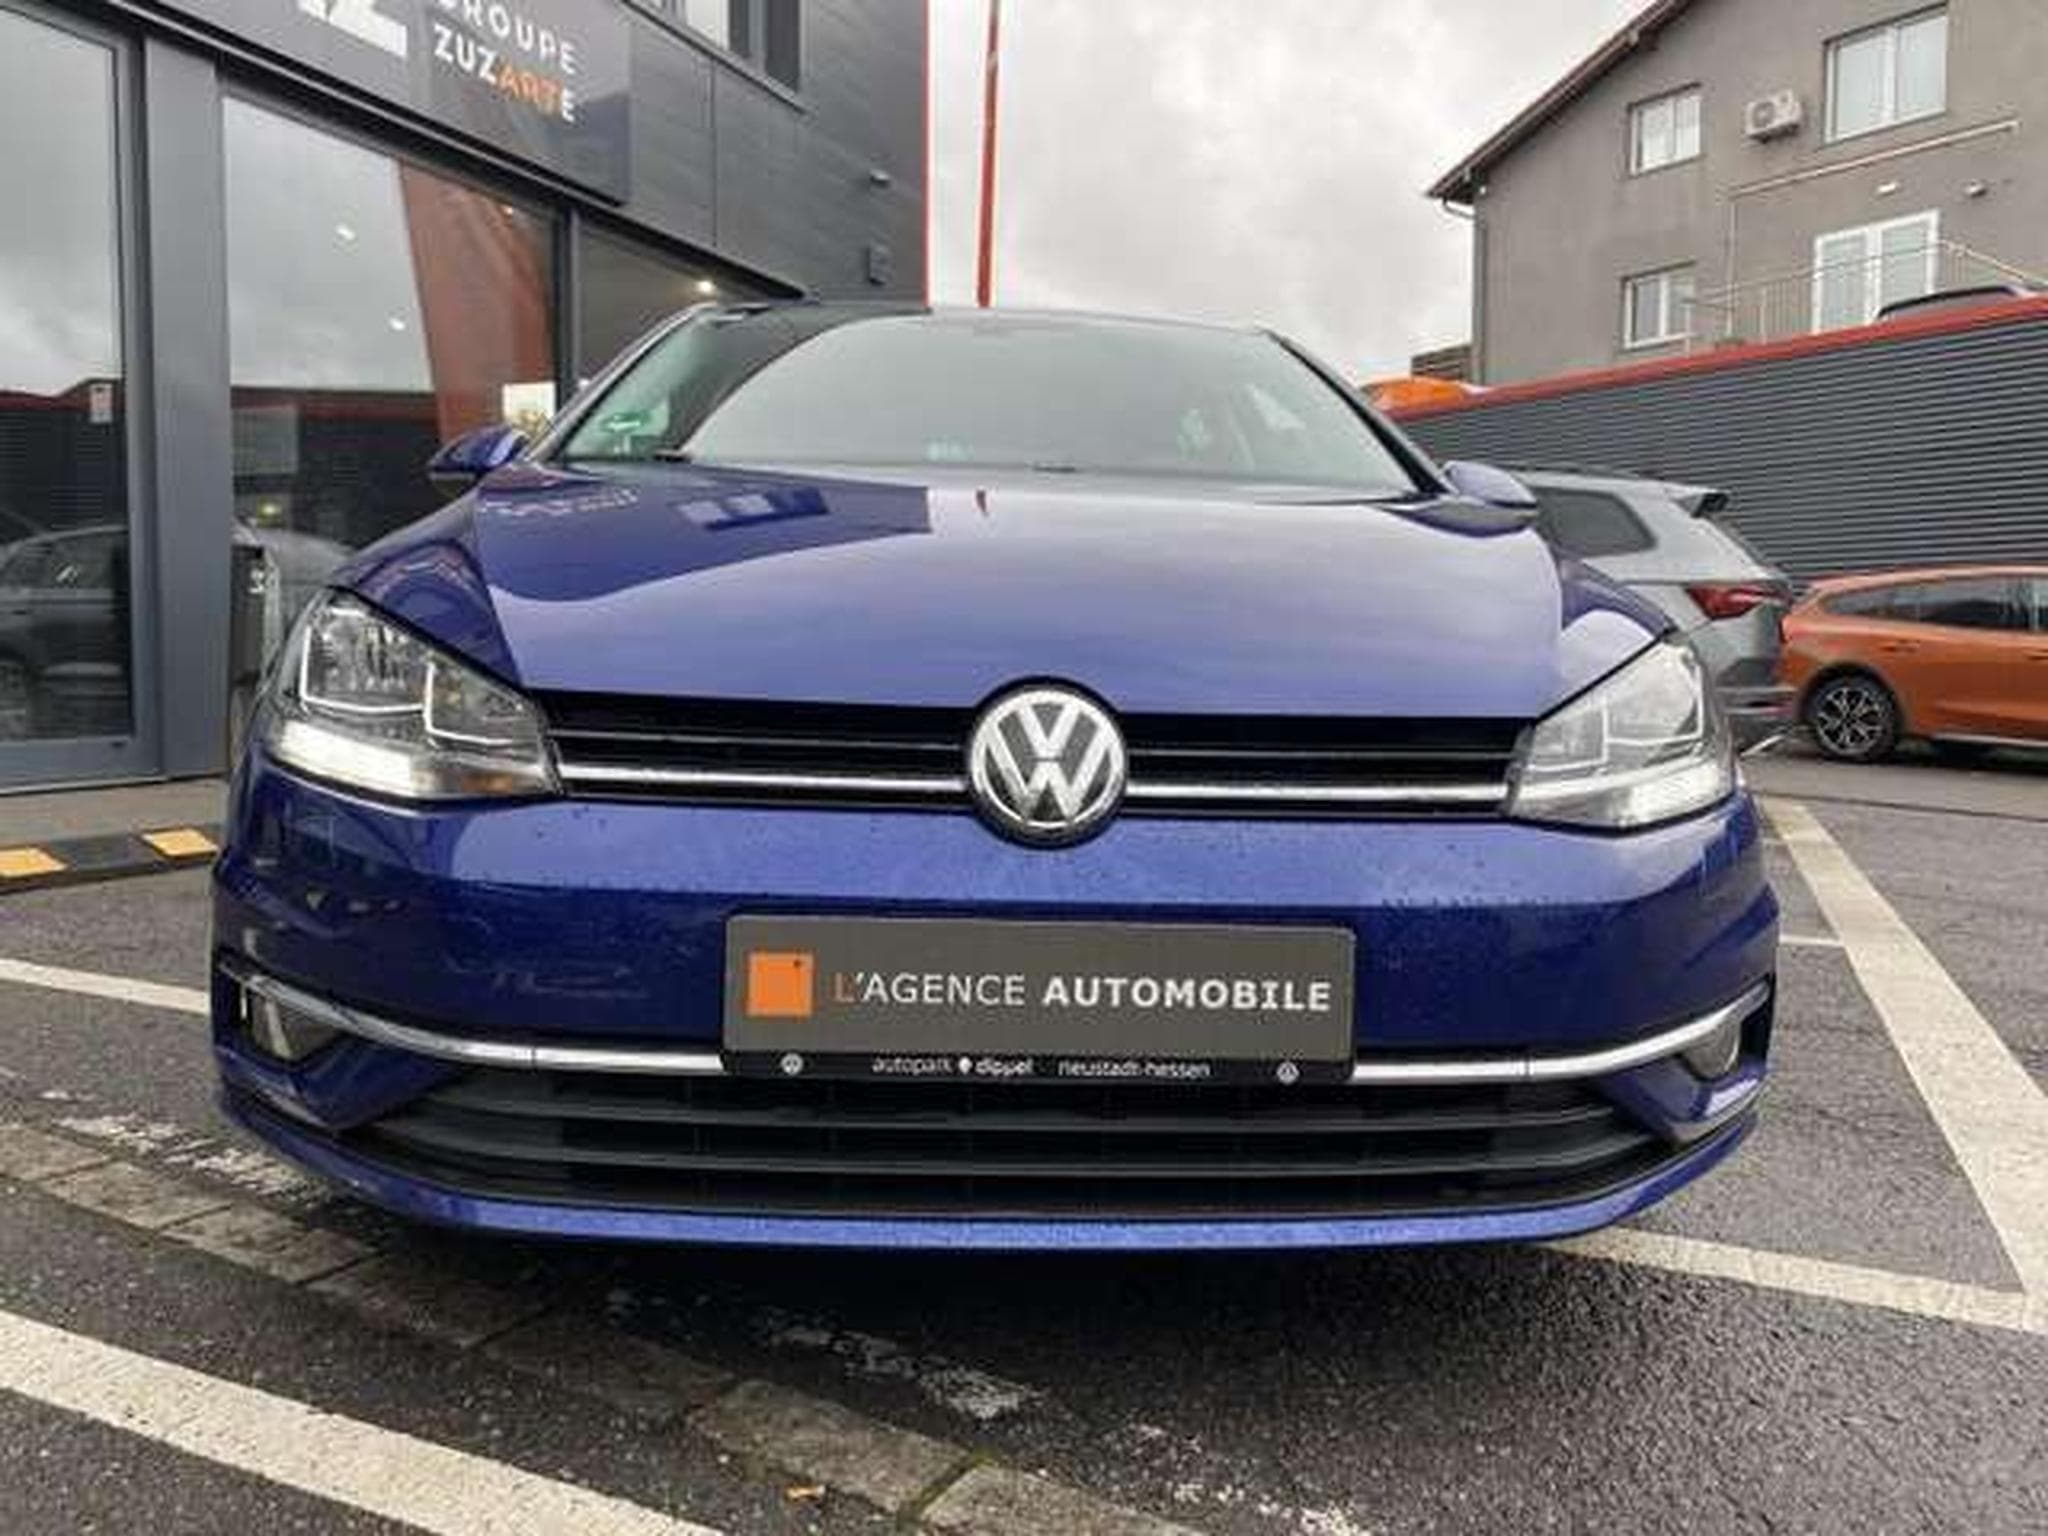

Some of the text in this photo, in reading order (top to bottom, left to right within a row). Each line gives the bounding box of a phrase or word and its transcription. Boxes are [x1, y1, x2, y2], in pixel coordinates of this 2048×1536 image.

[434, 22, 576, 122] ZUZARTE
[438, 0, 576, 75] ROUPE
[1042, 977, 1332, 1012] AUTOMOBILE
